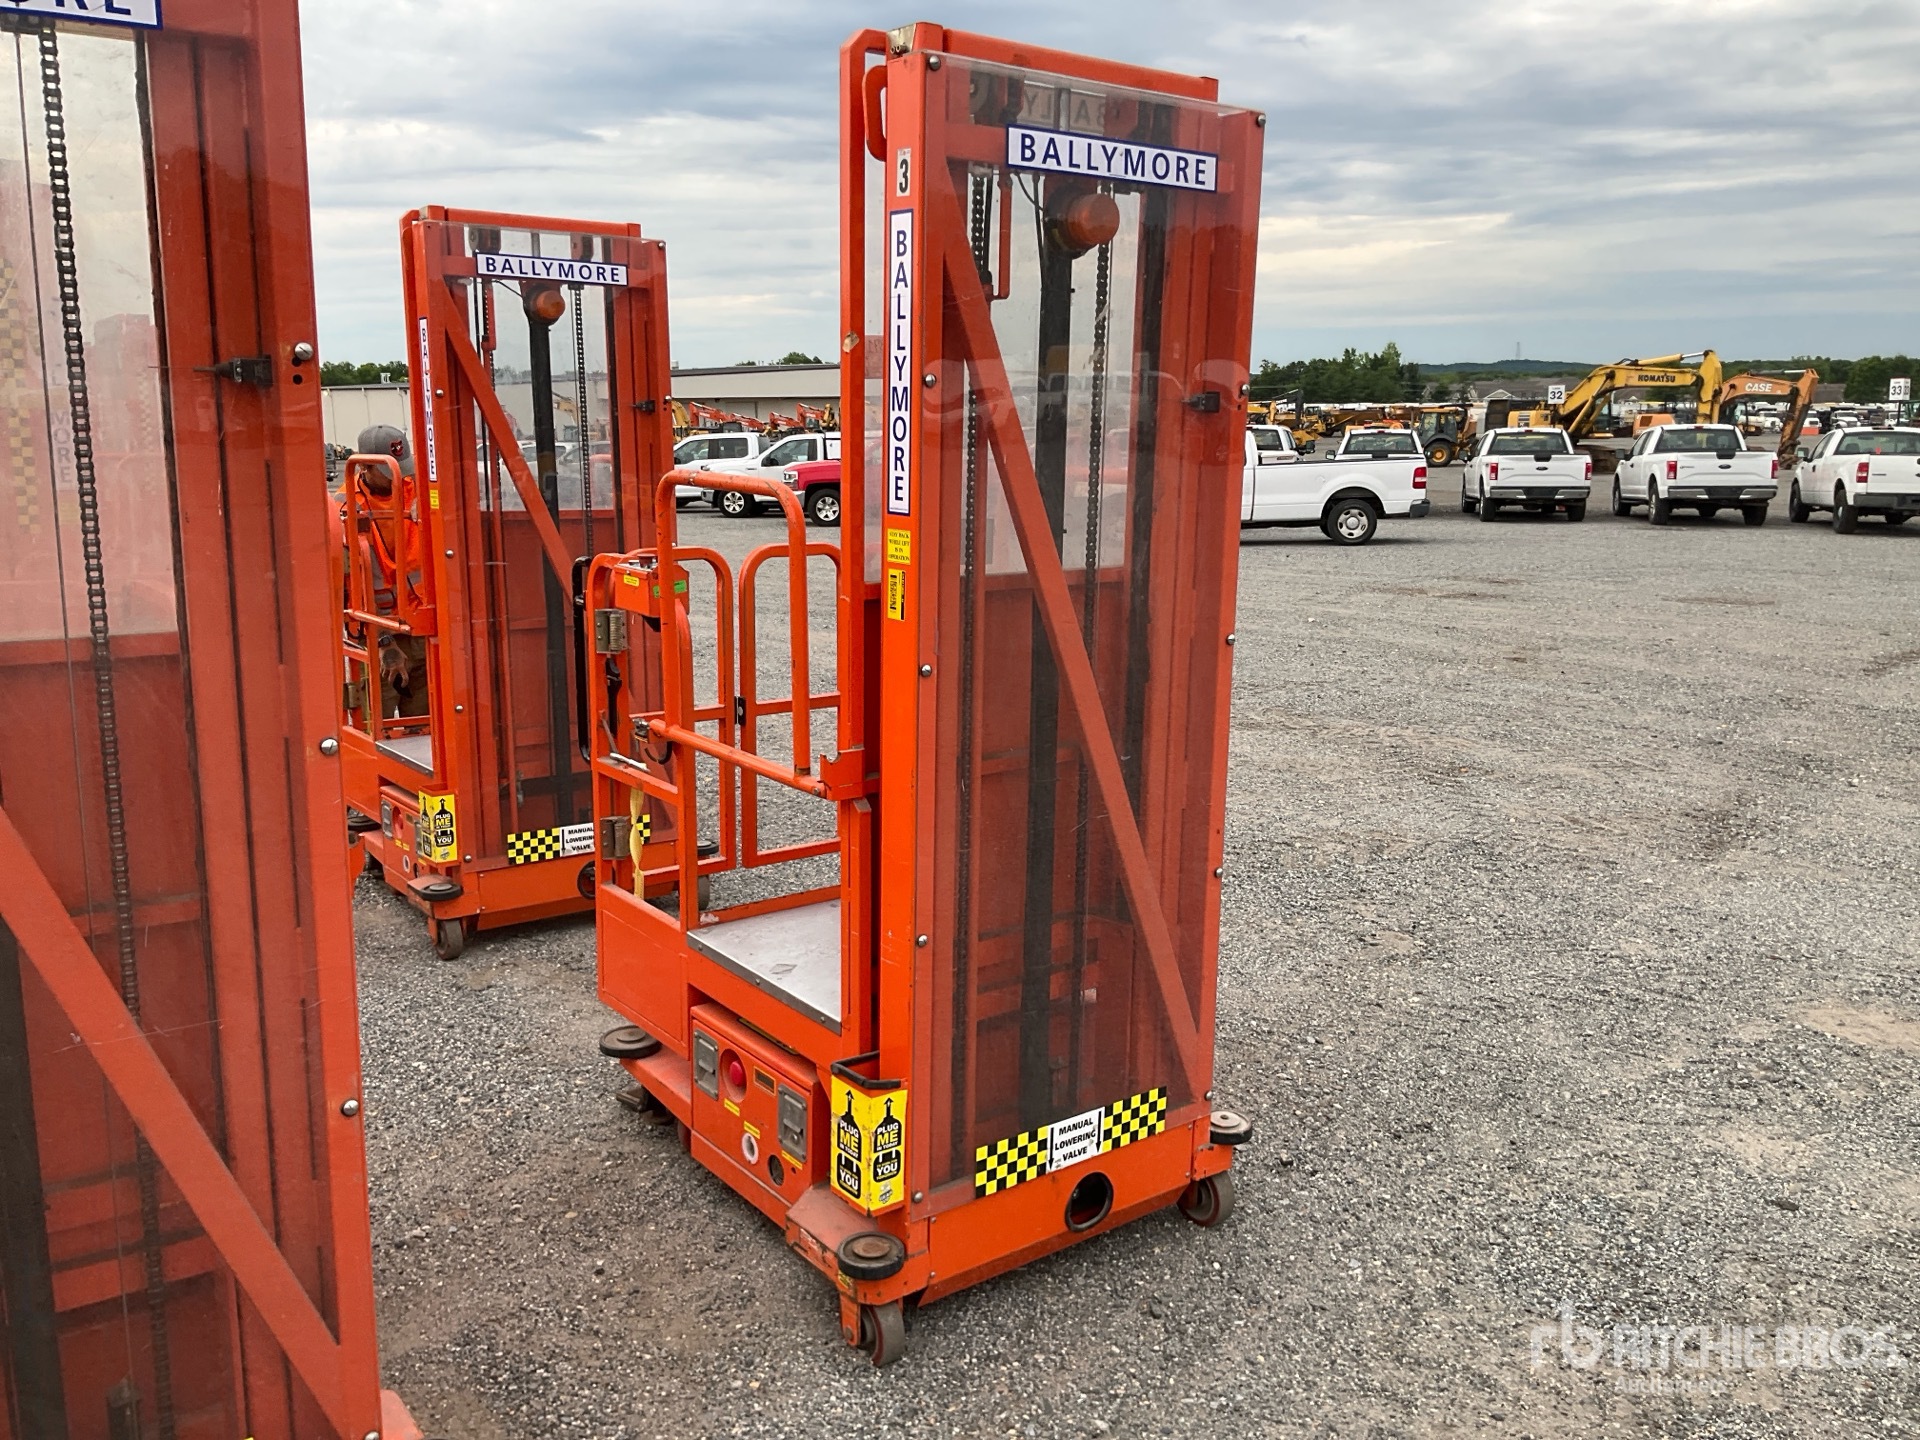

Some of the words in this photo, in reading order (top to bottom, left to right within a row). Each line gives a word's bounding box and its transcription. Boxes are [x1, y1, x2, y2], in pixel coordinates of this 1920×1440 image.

[1020, 132, 1207, 186] BALLYMORE
[899, 158, 909, 193] 3
[486, 256, 620, 283] BALLYMORE
[891, 229, 909, 502] BALLYMORE
[1638, 374, 1676, 383] KOMATSU
[1549, 390, 1563, 400] 32
[1745, 383, 1772, 393] CASE
[1890, 385, 1902, 396] 33
[421, 328, 436, 475] BALLYMORE
[436, 818, 451, 826] ME
[566, 835, 594, 844] LOWERIN
[840, 1119, 859, 1139] PLUG
[877, 1122, 898, 1135] PLUG
[1059, 1117, 1094, 1136] MANUAL
[840, 1128, 859, 1153] ME
[877, 1130, 898, 1147] ME
[1054, 1130, 1096, 1151] LOWERING
[1062, 1146, 1088, 1162] VALVE
[877, 1162, 898, 1176] YOU
[840, 1168, 859, 1191] YOU
